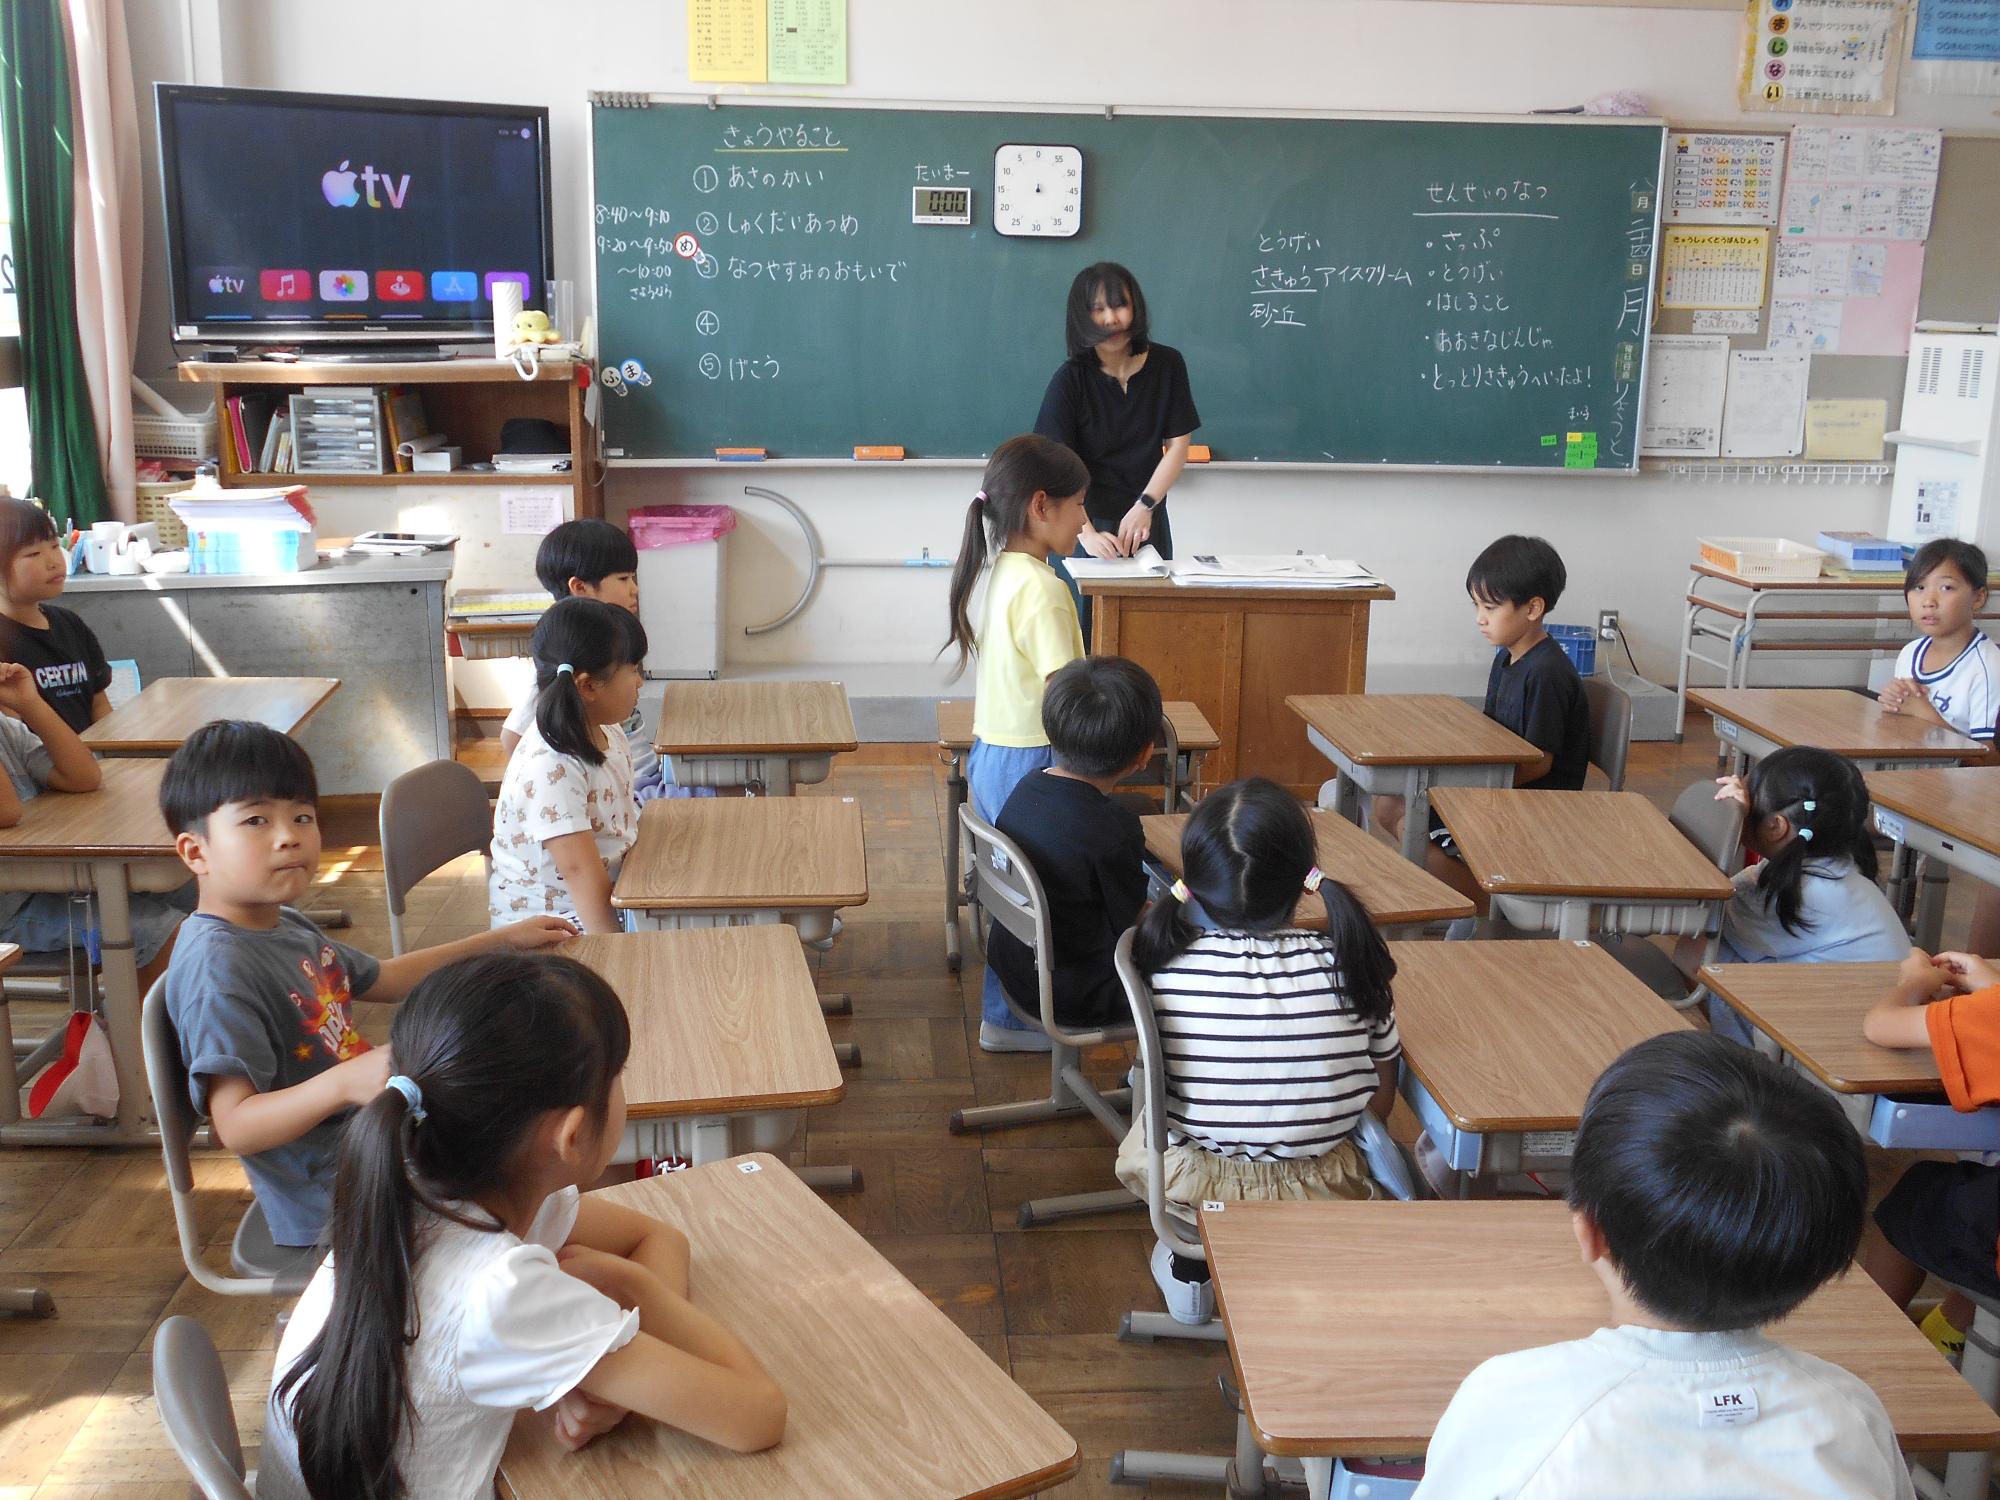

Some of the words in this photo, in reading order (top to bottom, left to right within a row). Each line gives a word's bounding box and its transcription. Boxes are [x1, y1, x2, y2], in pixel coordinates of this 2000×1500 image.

[723, 122, 841, 148] きょうやること
[728, 164, 824, 189] あさのかい
[728, 256, 908, 282] なつやすみのおもいで
[1250, 302, 1306, 328] 砂丘
[729, 354, 780, 381] げこう
[1714, 1394, 1743, 1407] LFK
